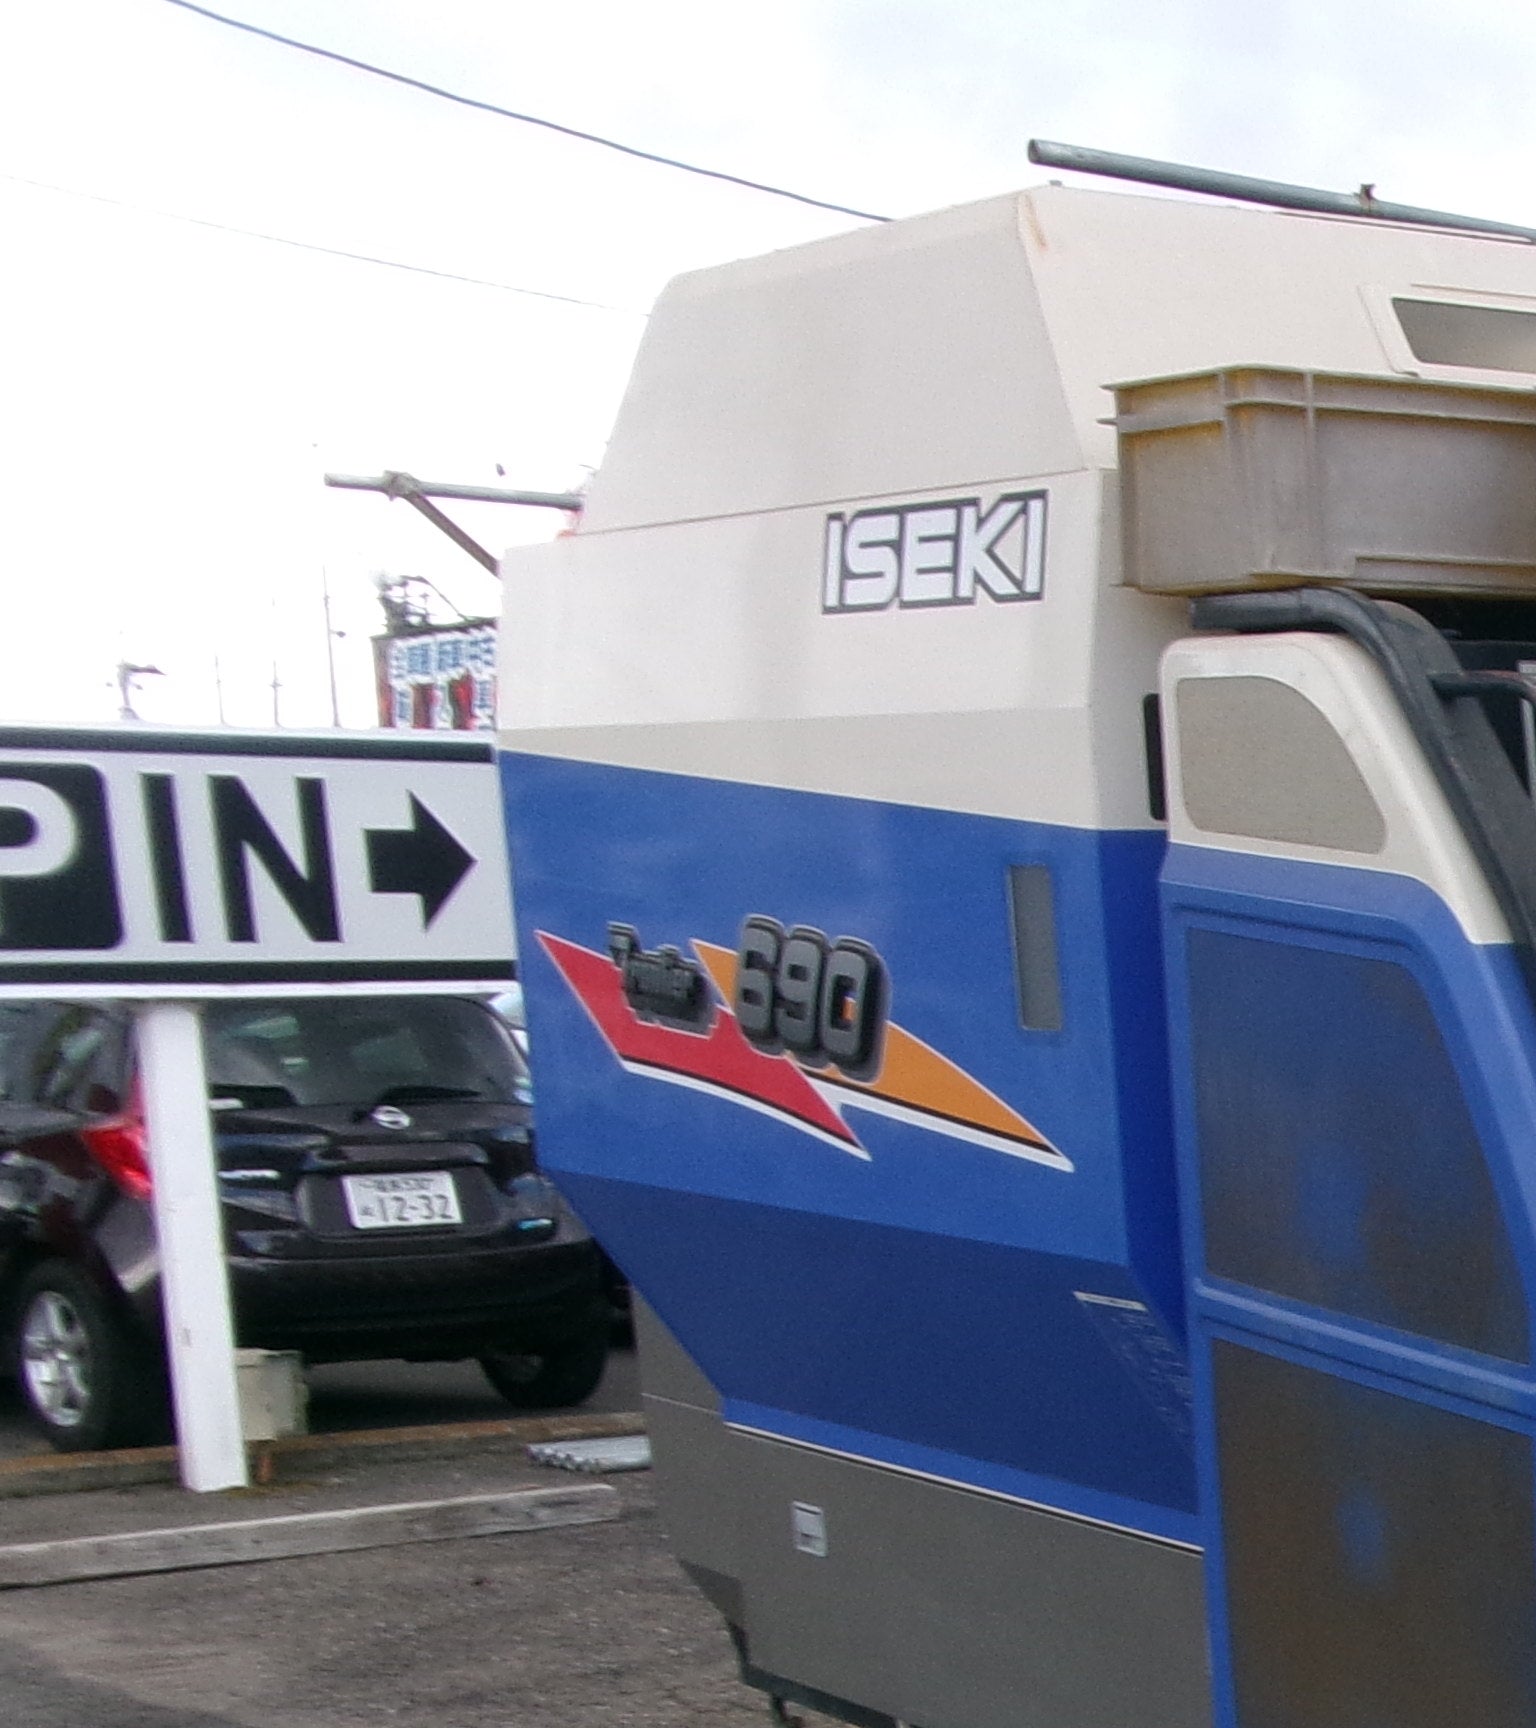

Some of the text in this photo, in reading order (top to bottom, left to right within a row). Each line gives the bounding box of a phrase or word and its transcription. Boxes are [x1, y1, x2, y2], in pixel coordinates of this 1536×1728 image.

[822, 489, 1048, 614] ISEKI
[138, 770, 345, 943] IN
[737, 914, 888, 1062] 690
[377, 1193, 453, 1221] 12-32
